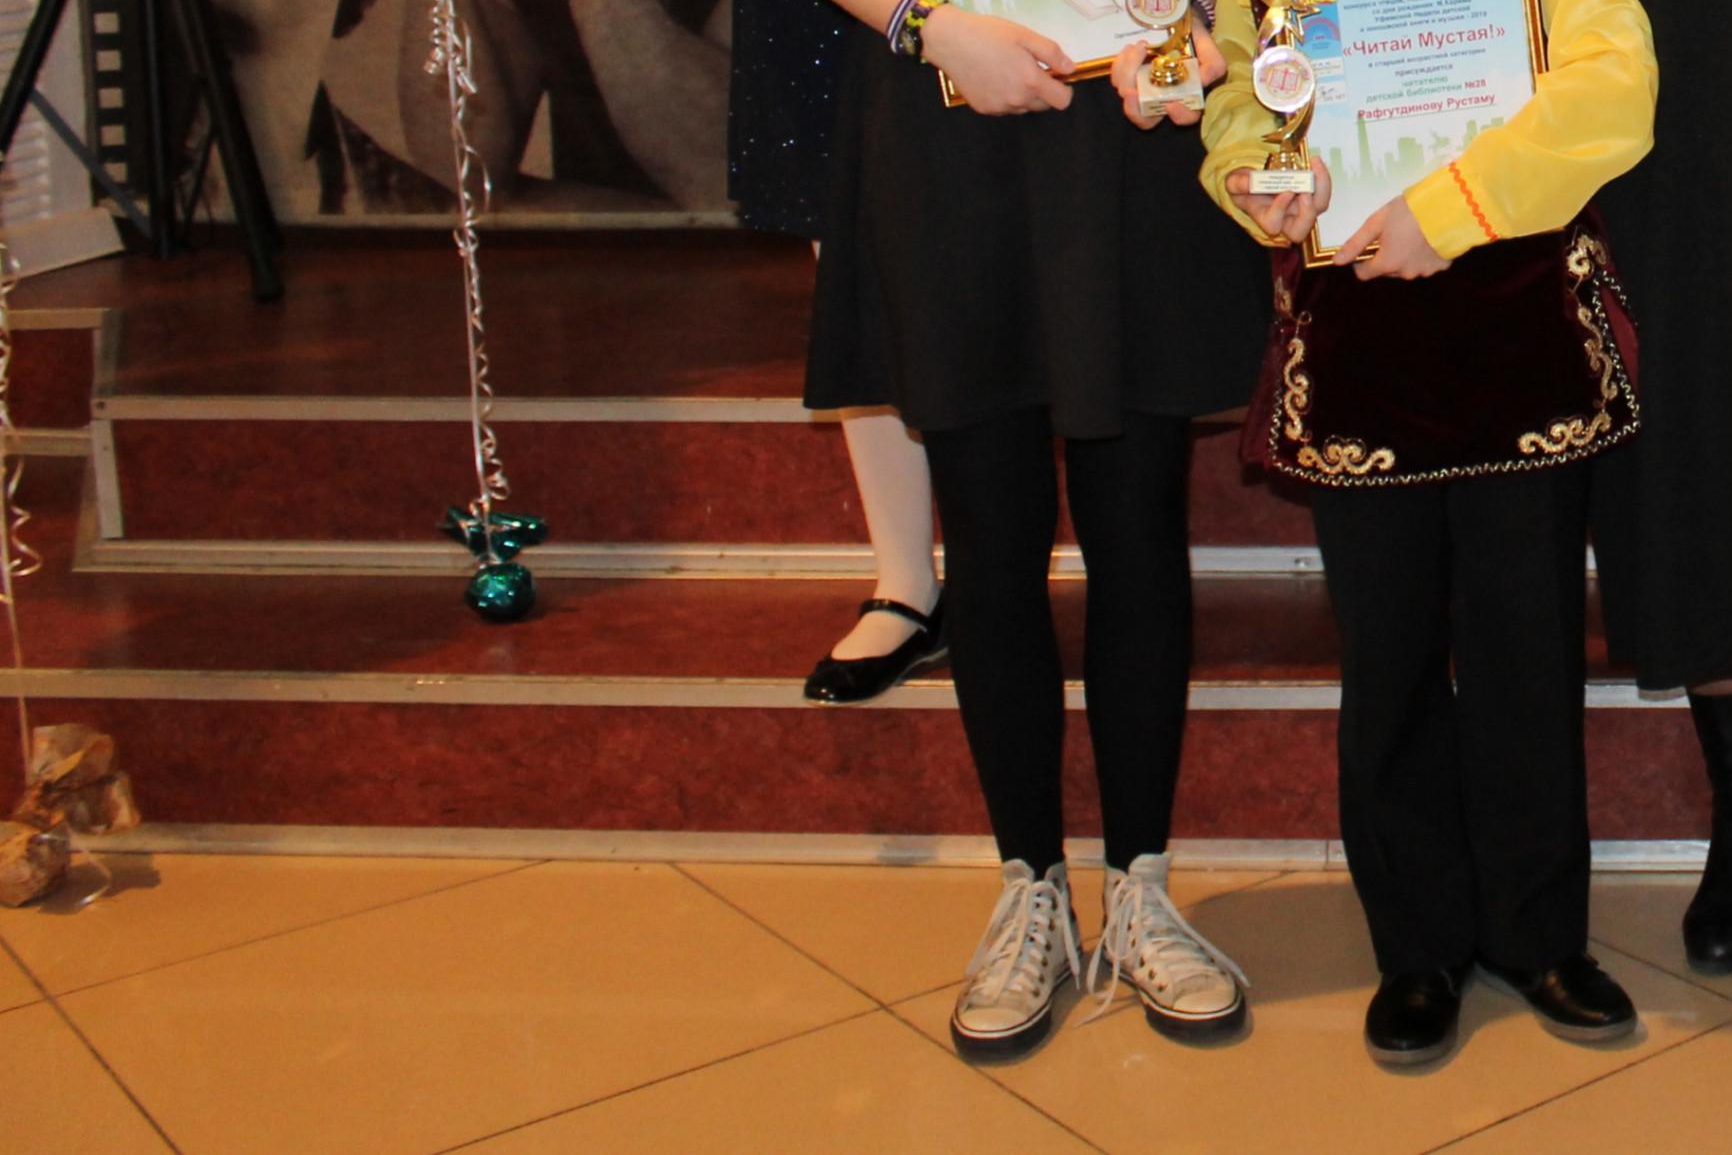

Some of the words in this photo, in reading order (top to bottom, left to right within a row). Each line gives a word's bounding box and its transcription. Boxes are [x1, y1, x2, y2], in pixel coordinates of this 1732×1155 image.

[1341, 35, 1412, 56] «Читай
[1417, 23, 1505, 50] Мустая!»
[1446, 93, 1496, 108] Рустаму
